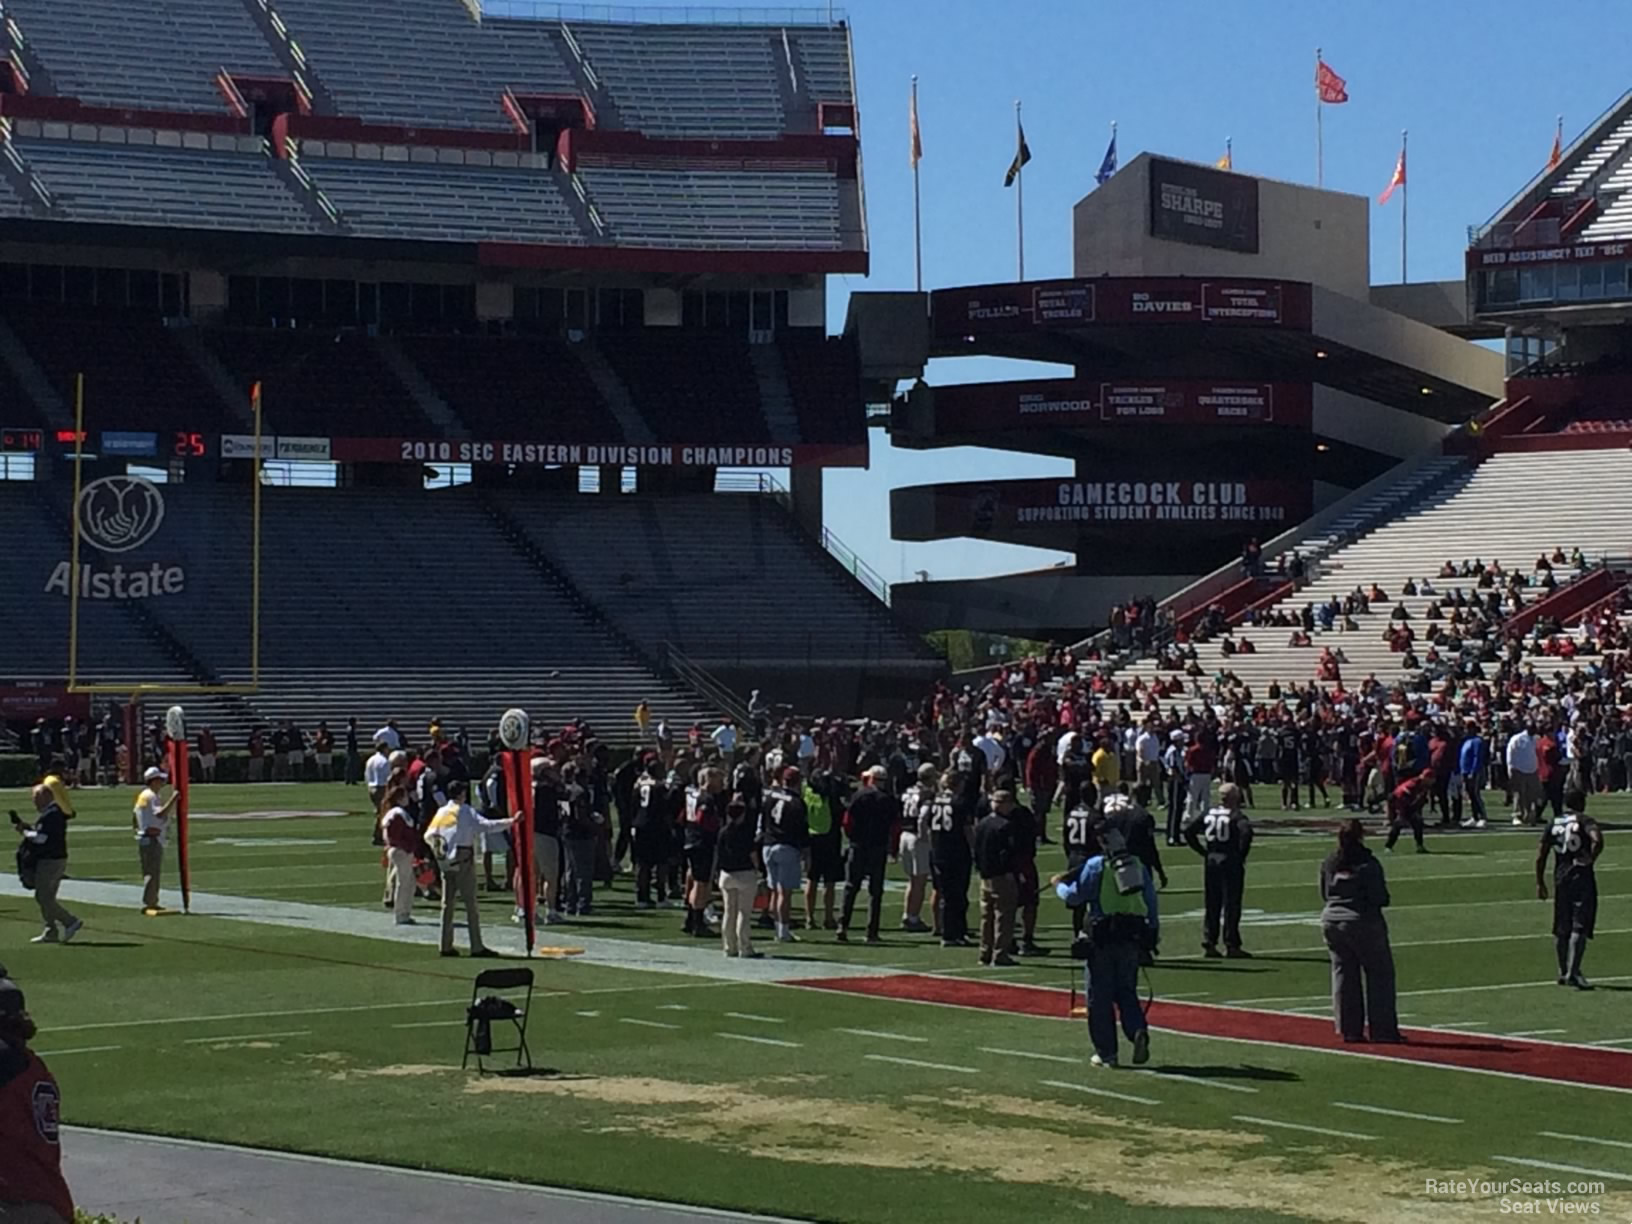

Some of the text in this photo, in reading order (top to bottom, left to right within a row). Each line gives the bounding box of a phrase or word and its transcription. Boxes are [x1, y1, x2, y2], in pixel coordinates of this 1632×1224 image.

[1161, 193, 1223, 219] SHARPE
[1483, 254, 1506, 264] NEED
[1132, 301, 1192, 312] DAVIES
[1020, 401, 1090, 413] NORWOOD
[175, 432, 205, 456] 25
[401, 442, 793, 465] 2010 SEC EASTERN DIVISION CHAMPIONS
[1058, 482, 1247, 505] GAMECOCK CLUB
[1017, 506, 1089, 522] SUPPORTING
[1094, 505, 1151, 520] STUDENT
[1155, 506, 1216, 520] ATHLETES
[1221, 506, 1256, 520] SINCE
[640, 785, 650, 807] 9
[771, 799, 785, 825] 4
[931, 804, 953, 831] 26
[1067, 818, 1086, 844] 21
[1204, 815, 1231, 842] 20
[1552, 822, 1581, 854] 36
